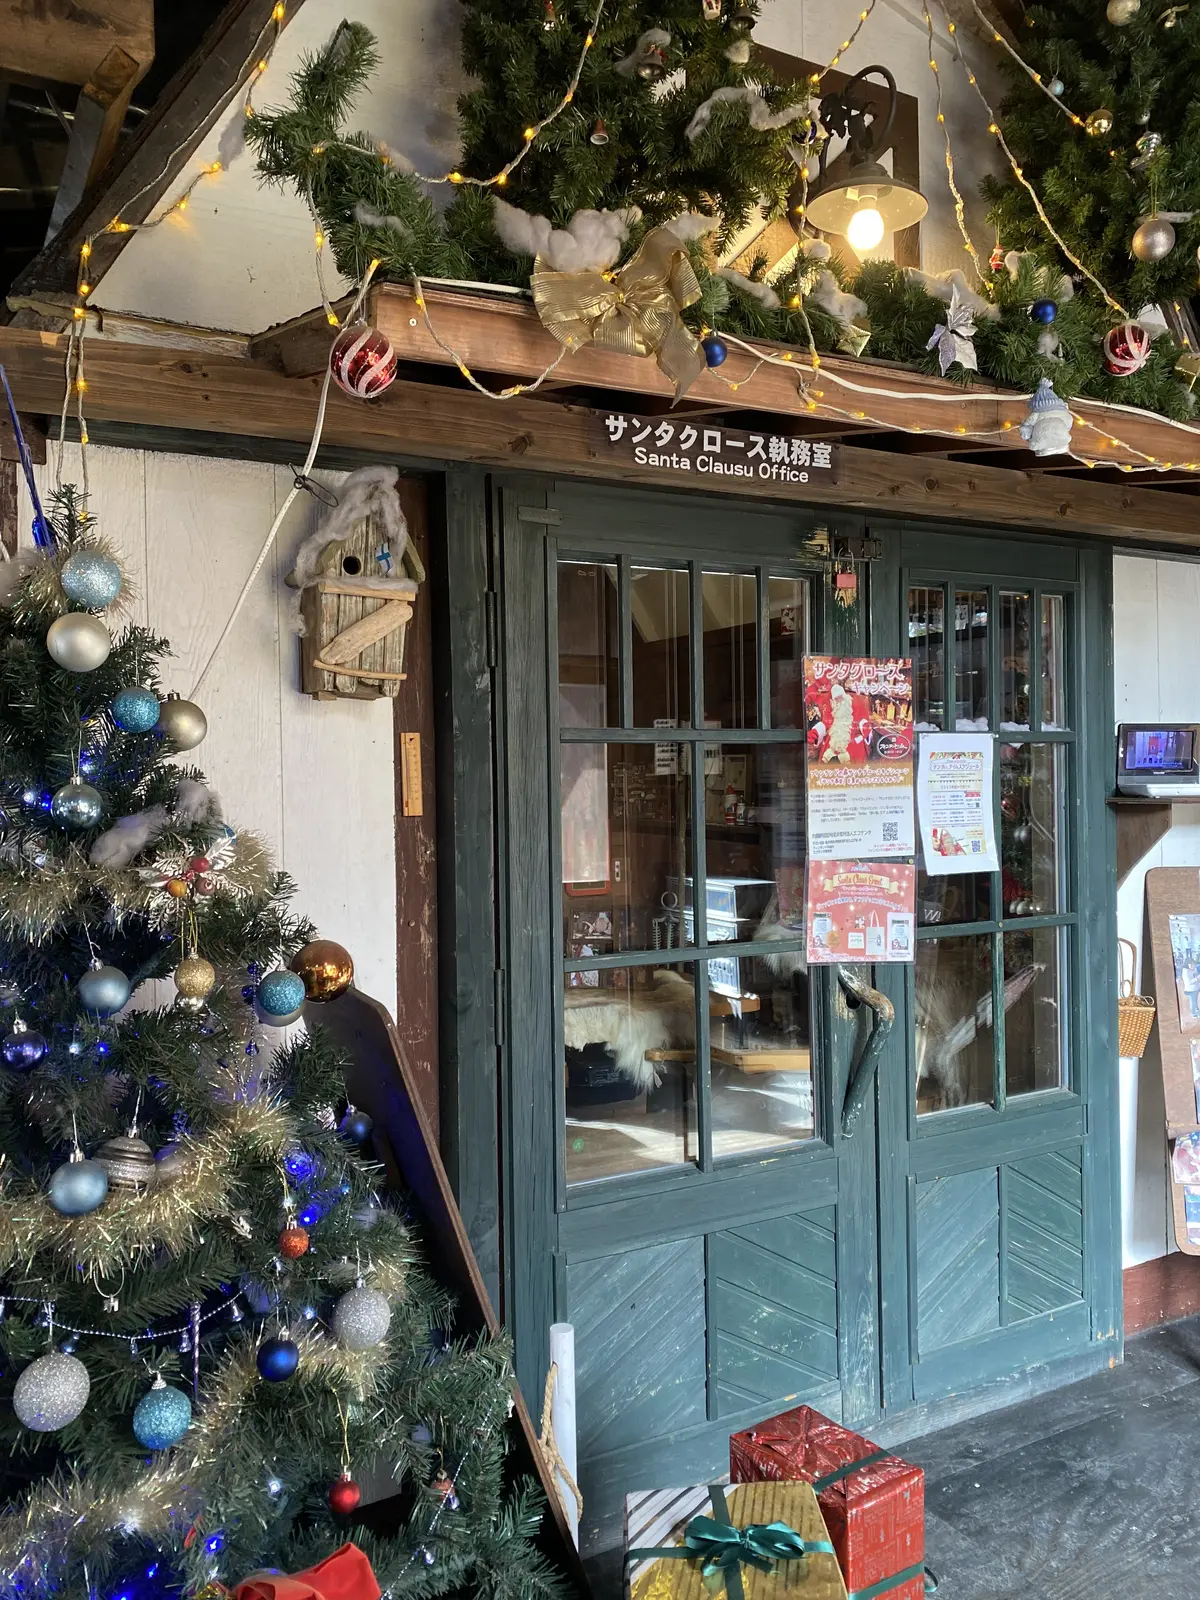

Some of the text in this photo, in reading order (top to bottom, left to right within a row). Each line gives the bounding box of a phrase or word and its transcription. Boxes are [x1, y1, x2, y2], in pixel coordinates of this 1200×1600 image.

[605, 414, 832, 469] サンタクロース執務室
[634, 447, 809, 483] Santa Clausu Office
[813, 661, 903, 680] サンタクロース
[851, 682, 909, 696] キャンペーン
